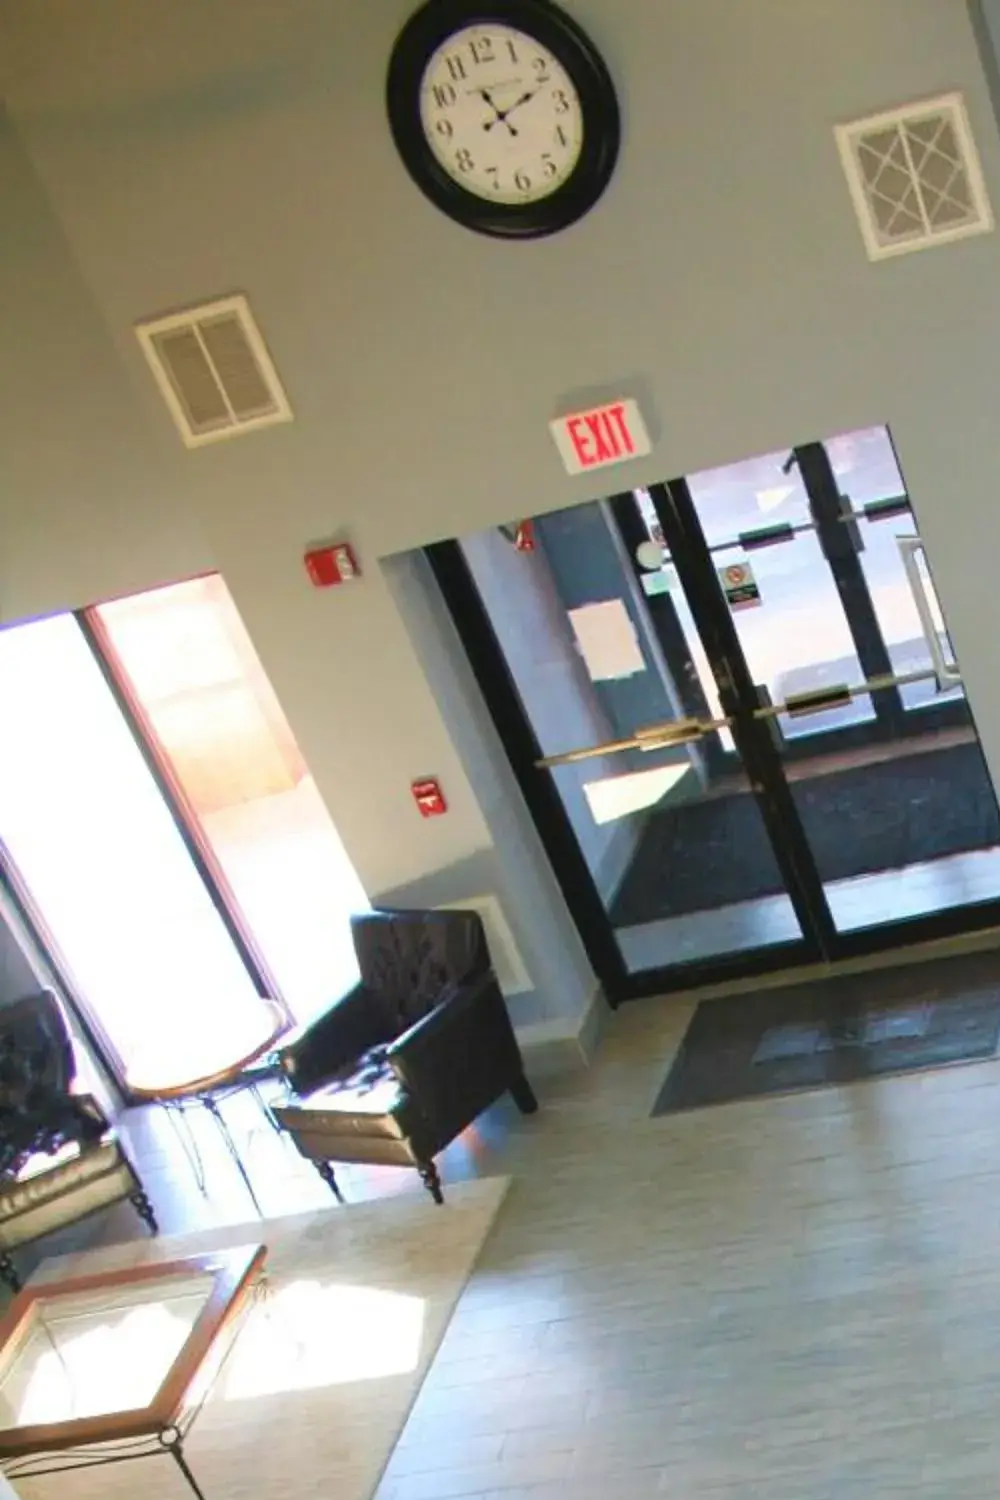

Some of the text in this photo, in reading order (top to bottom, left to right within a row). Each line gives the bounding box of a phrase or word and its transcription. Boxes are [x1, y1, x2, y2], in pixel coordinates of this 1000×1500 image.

[469, 36, 496, 65] 12
[505, 39, 519, 65] 1
[445, 54, 468, 81] 11
[532, 57, 550, 84] 2
[432, 82, 457, 109] 10
[551, 89, 570, 114] 3
[436, 119, 453, 139] 9
[455, 147, 475, 173] 8
[541, 152, 558, 177] 5
[484, 165, 500, 190] 7
[513, 167, 532, 192] 6
[567, 405, 635, 466] EXIT
